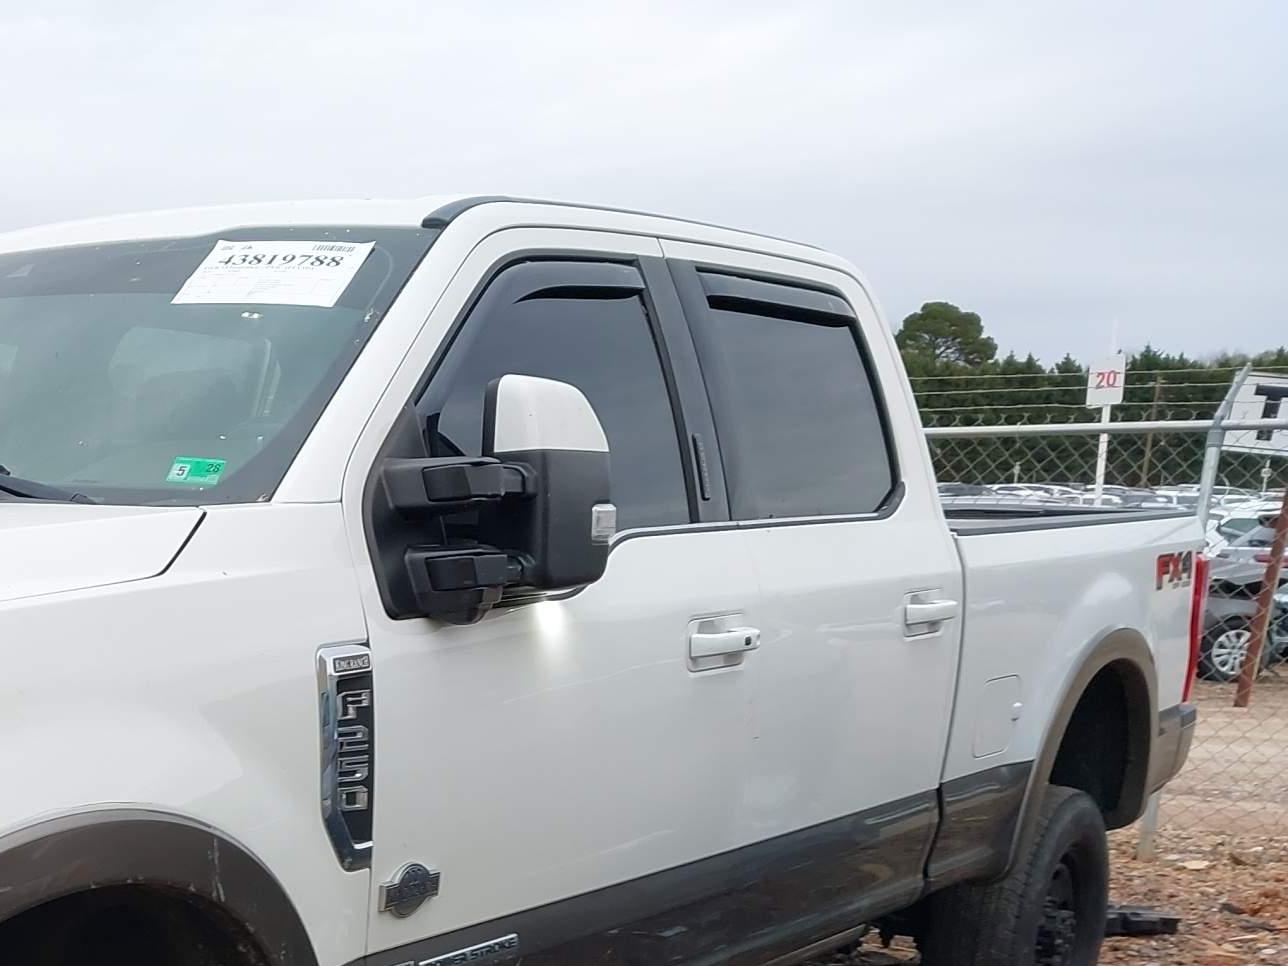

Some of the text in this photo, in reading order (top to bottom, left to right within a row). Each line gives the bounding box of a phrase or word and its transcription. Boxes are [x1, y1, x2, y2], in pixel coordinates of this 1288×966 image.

[218, 253, 344, 268] 43819788
[1096, 370, 1117, 389] 20
[1156, 551, 1192, 590] FX4
